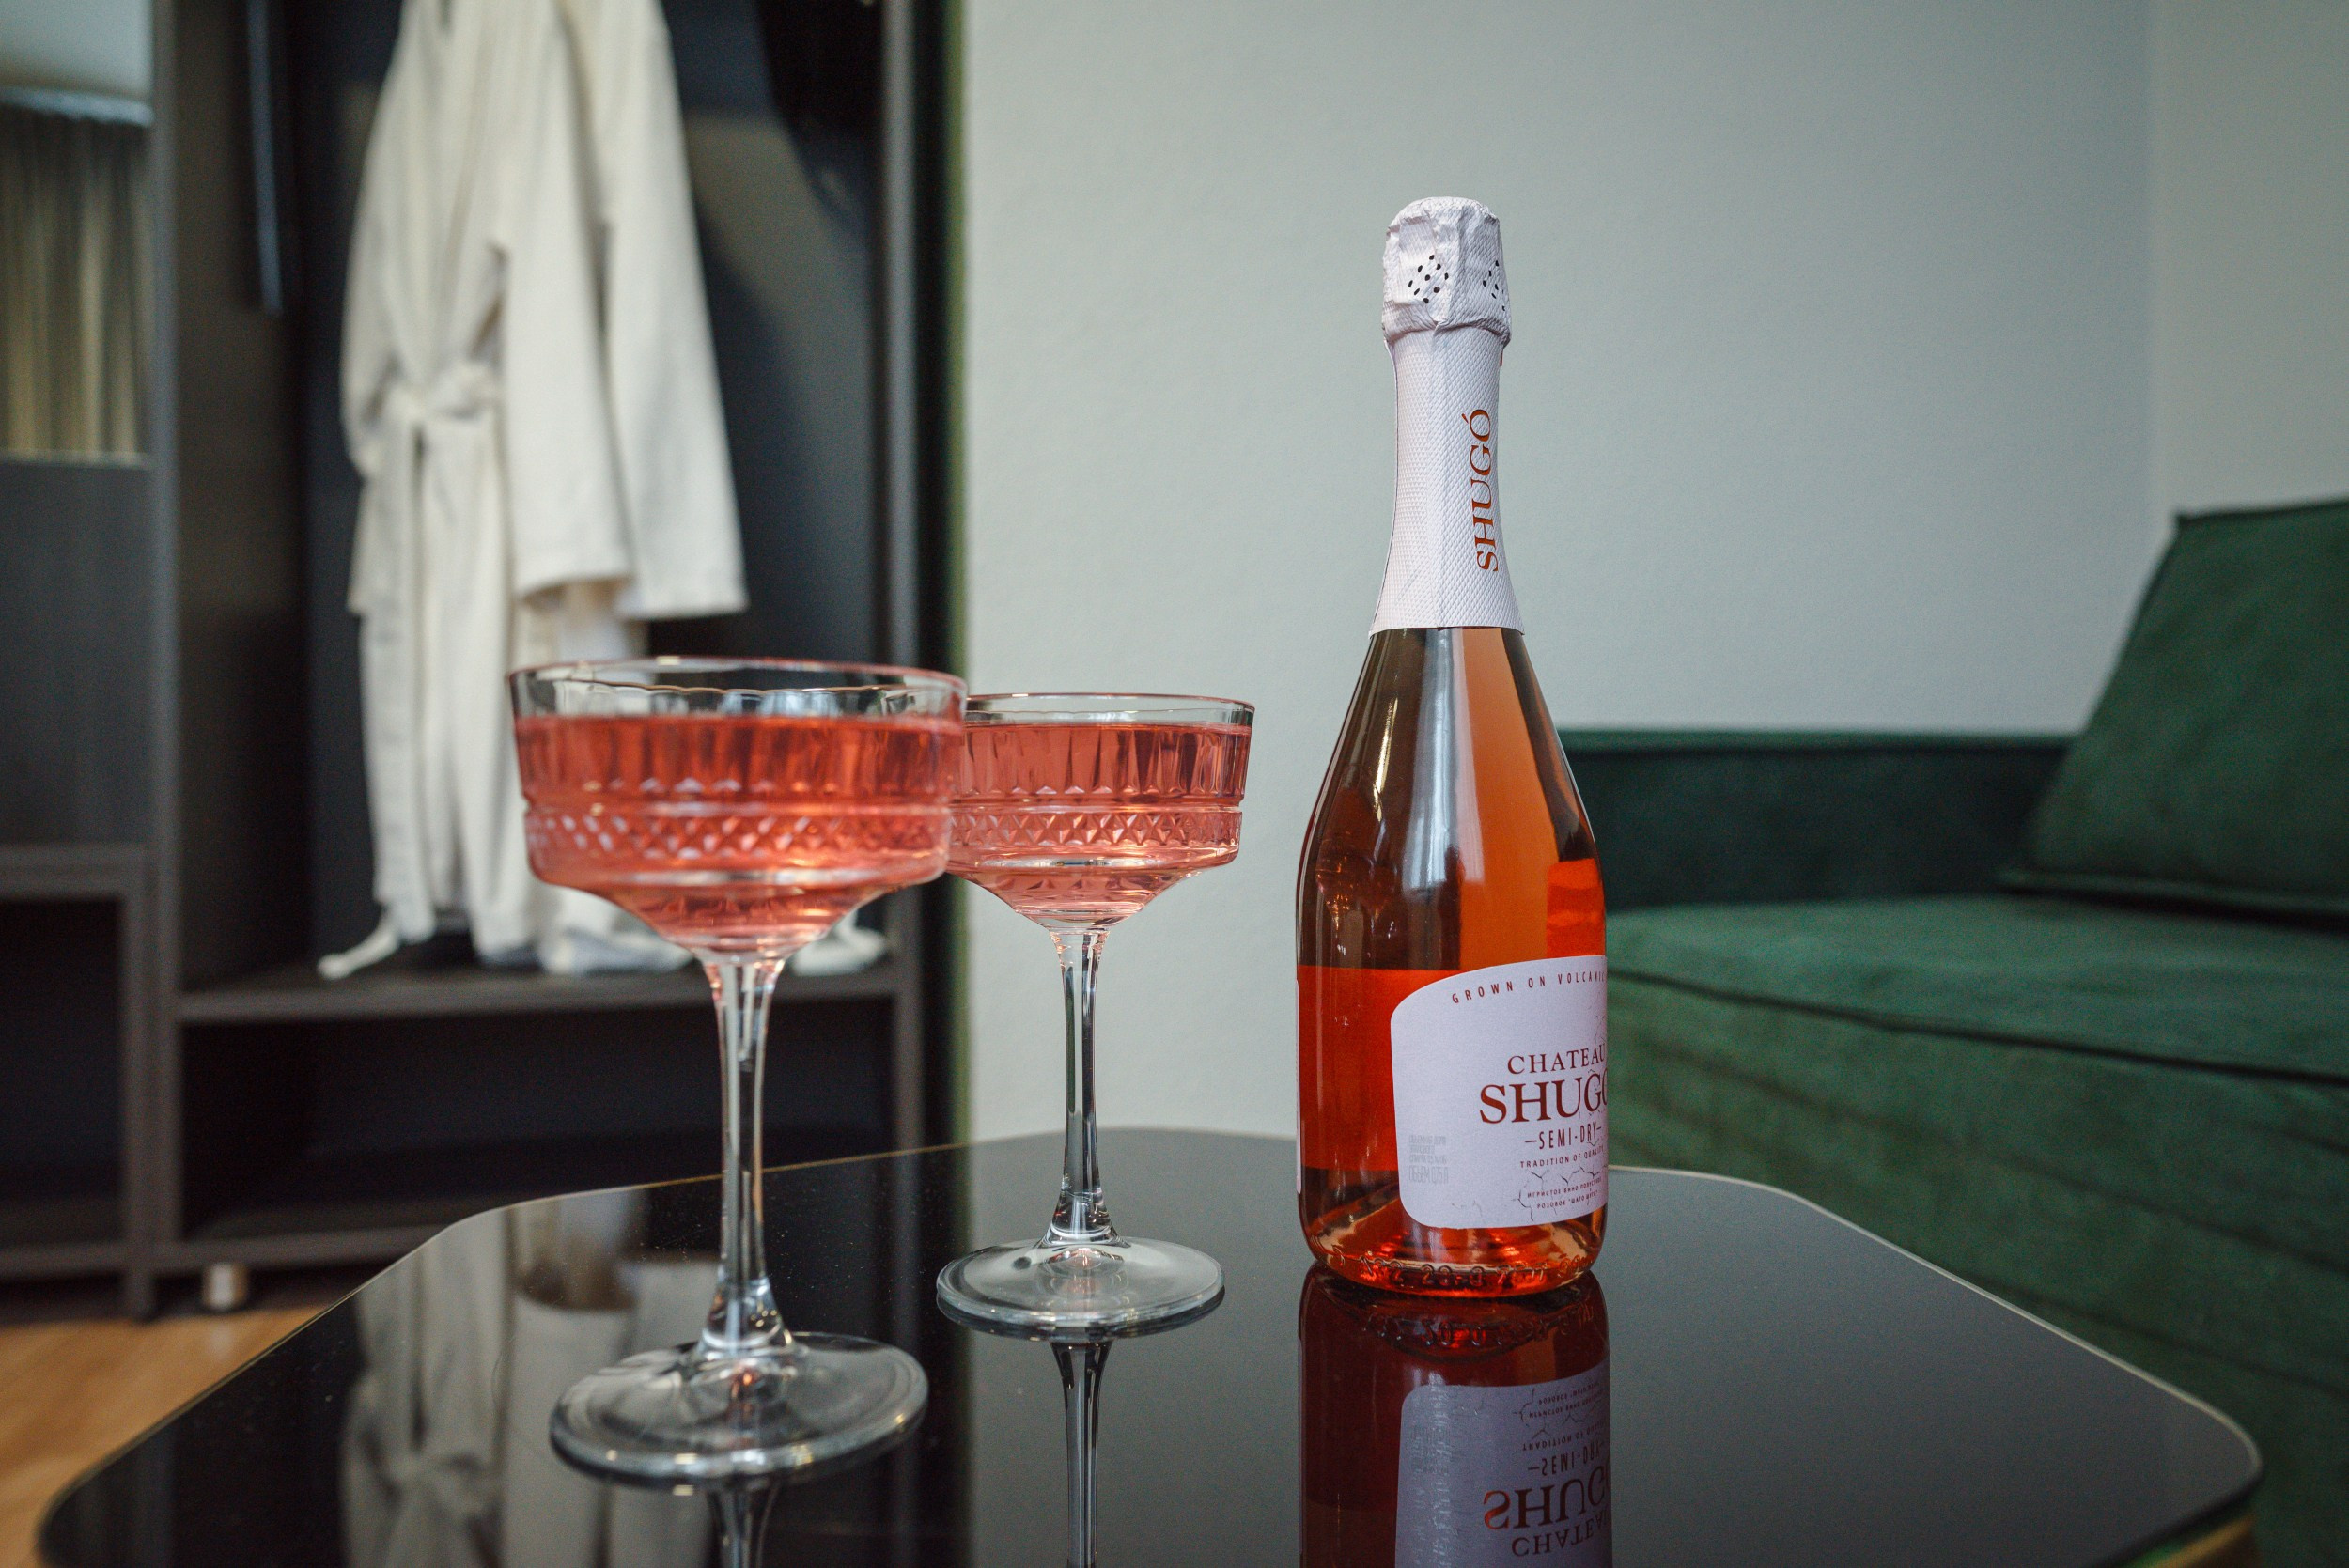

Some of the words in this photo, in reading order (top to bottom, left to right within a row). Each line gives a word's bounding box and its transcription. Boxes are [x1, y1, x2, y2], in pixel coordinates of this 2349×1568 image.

[1461, 409, 1499, 572] SHUGÓ
[1452, 981, 1514, 1004] GROWN
[1528, 976, 1546, 988] ON
[1507, 1043, 1606, 1075] CHATEAU
[1520, 1157, 1570, 1169] TRADITION
[1573, 1153, 1582, 1162] OF
